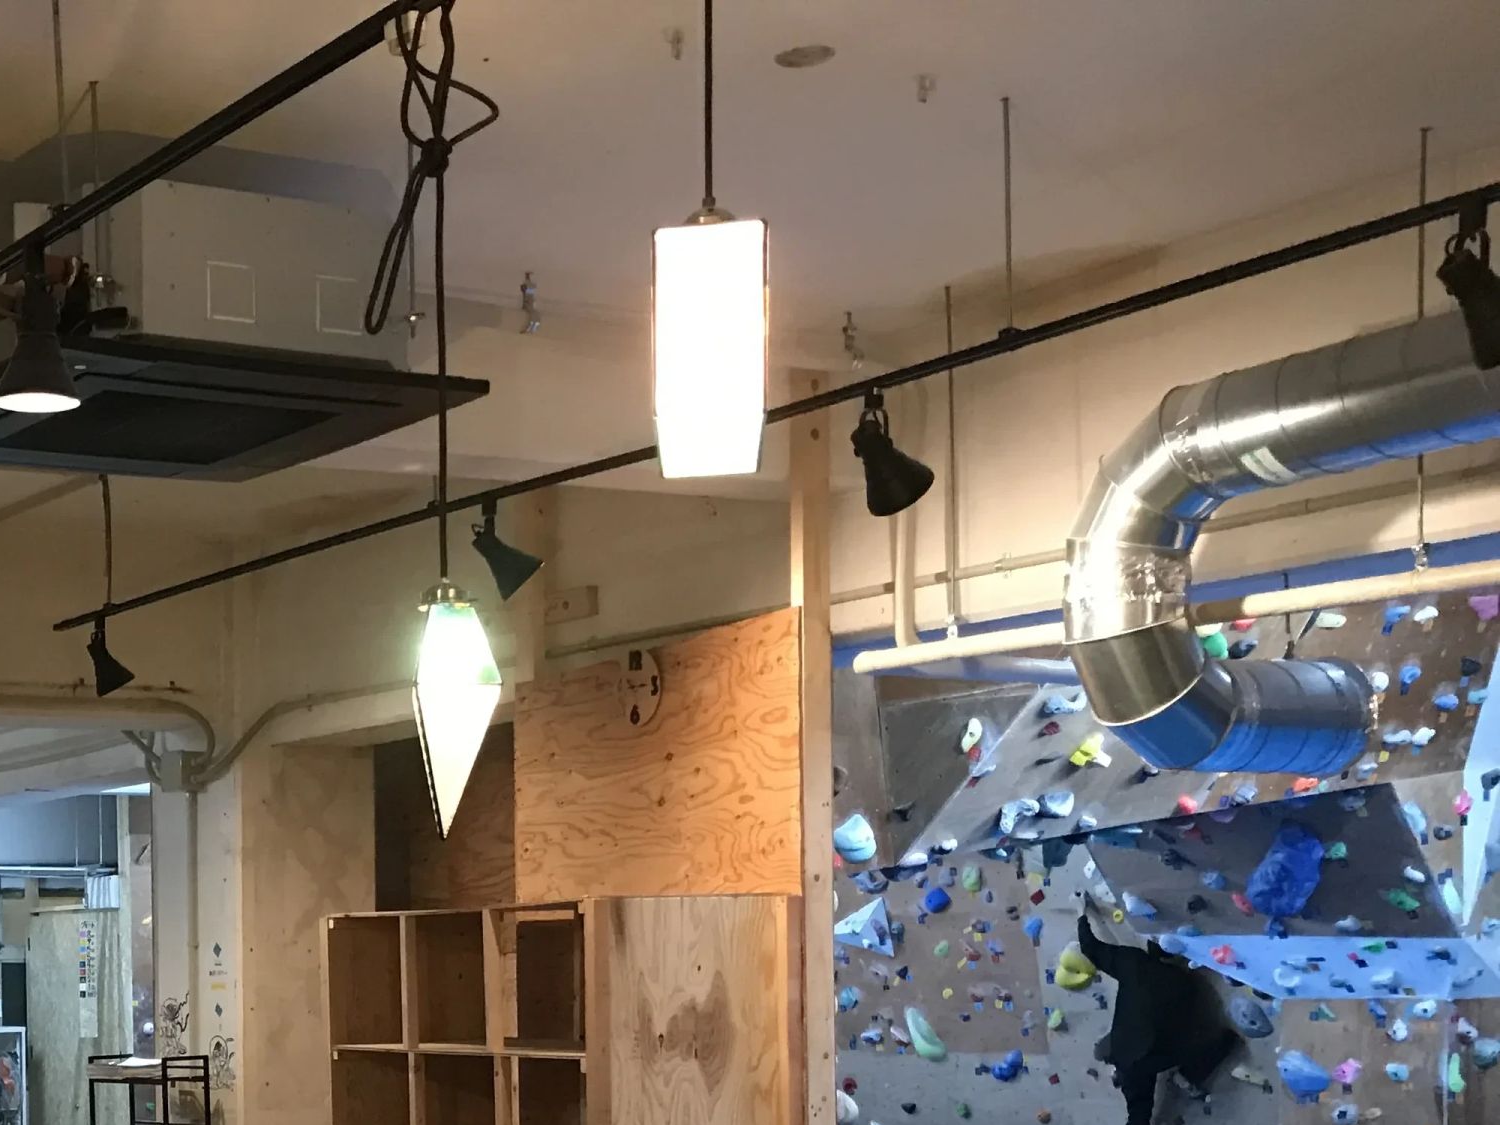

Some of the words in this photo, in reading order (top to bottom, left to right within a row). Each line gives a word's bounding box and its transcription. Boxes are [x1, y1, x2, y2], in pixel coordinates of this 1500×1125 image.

[629, 650, 642, 671] 12
[650, 675, 658, 696] 3
[630, 704, 640, 725] 6
